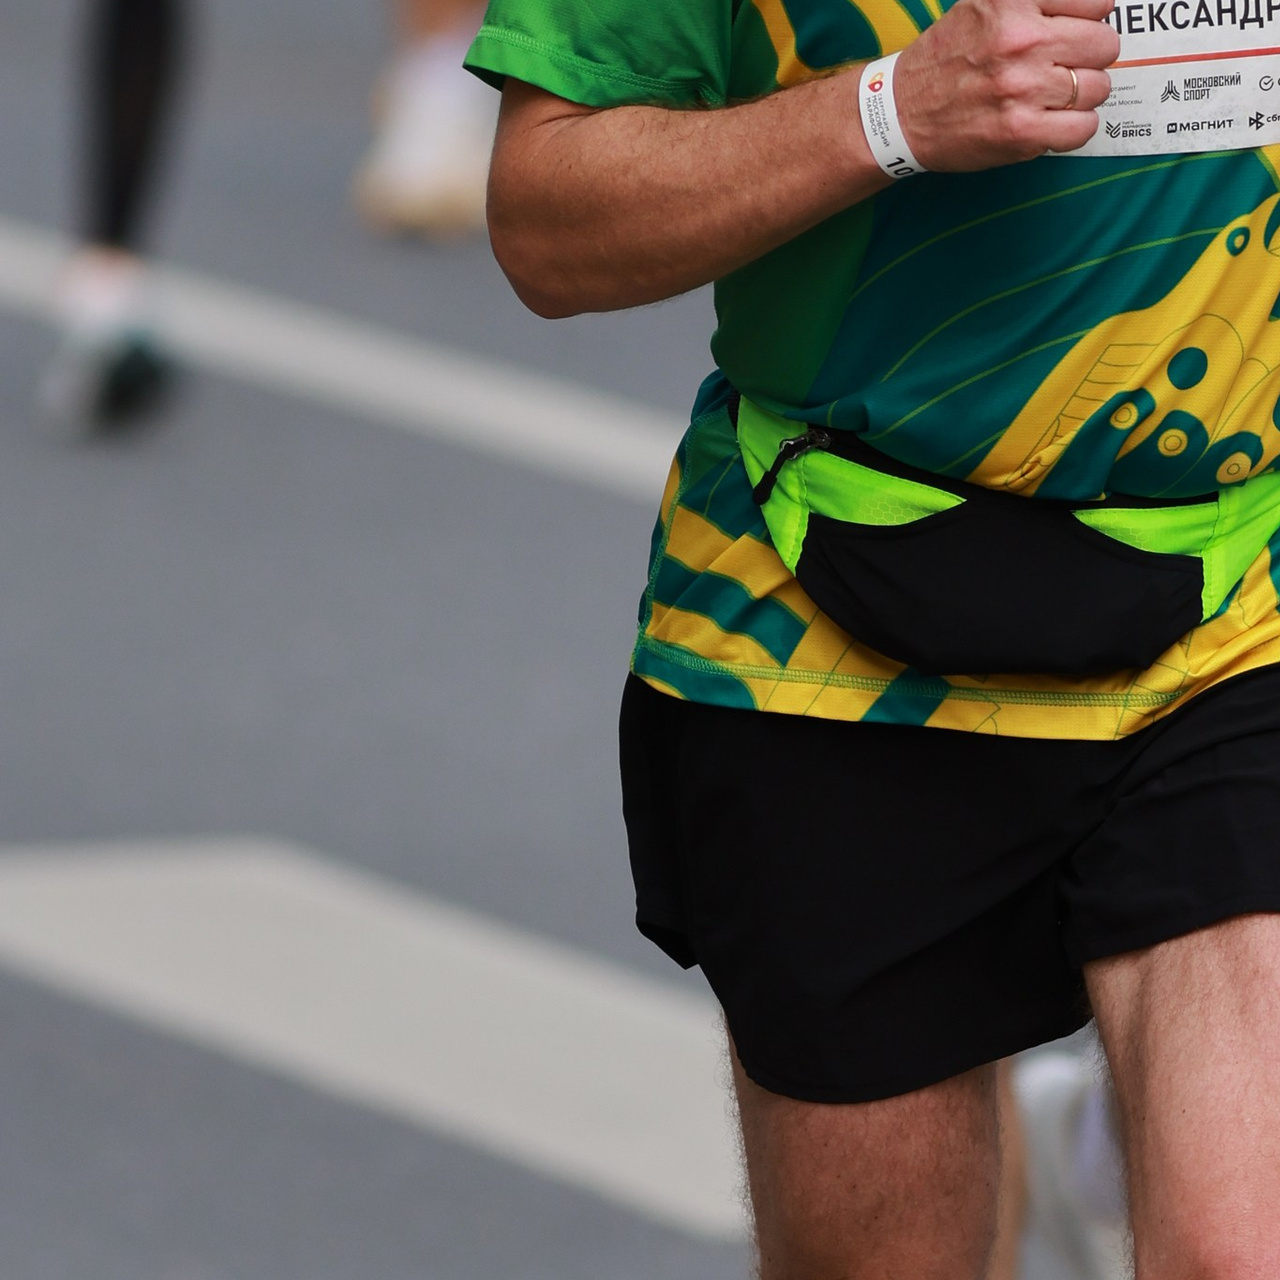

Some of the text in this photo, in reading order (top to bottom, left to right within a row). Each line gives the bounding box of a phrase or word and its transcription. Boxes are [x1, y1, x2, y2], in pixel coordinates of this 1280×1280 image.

[1183, 71, 1242, 90] МОСКОВСКИЙ
[1183, 88, 1211, 102] СПОРТ
[1121, 128, 1153, 138] BRICS
